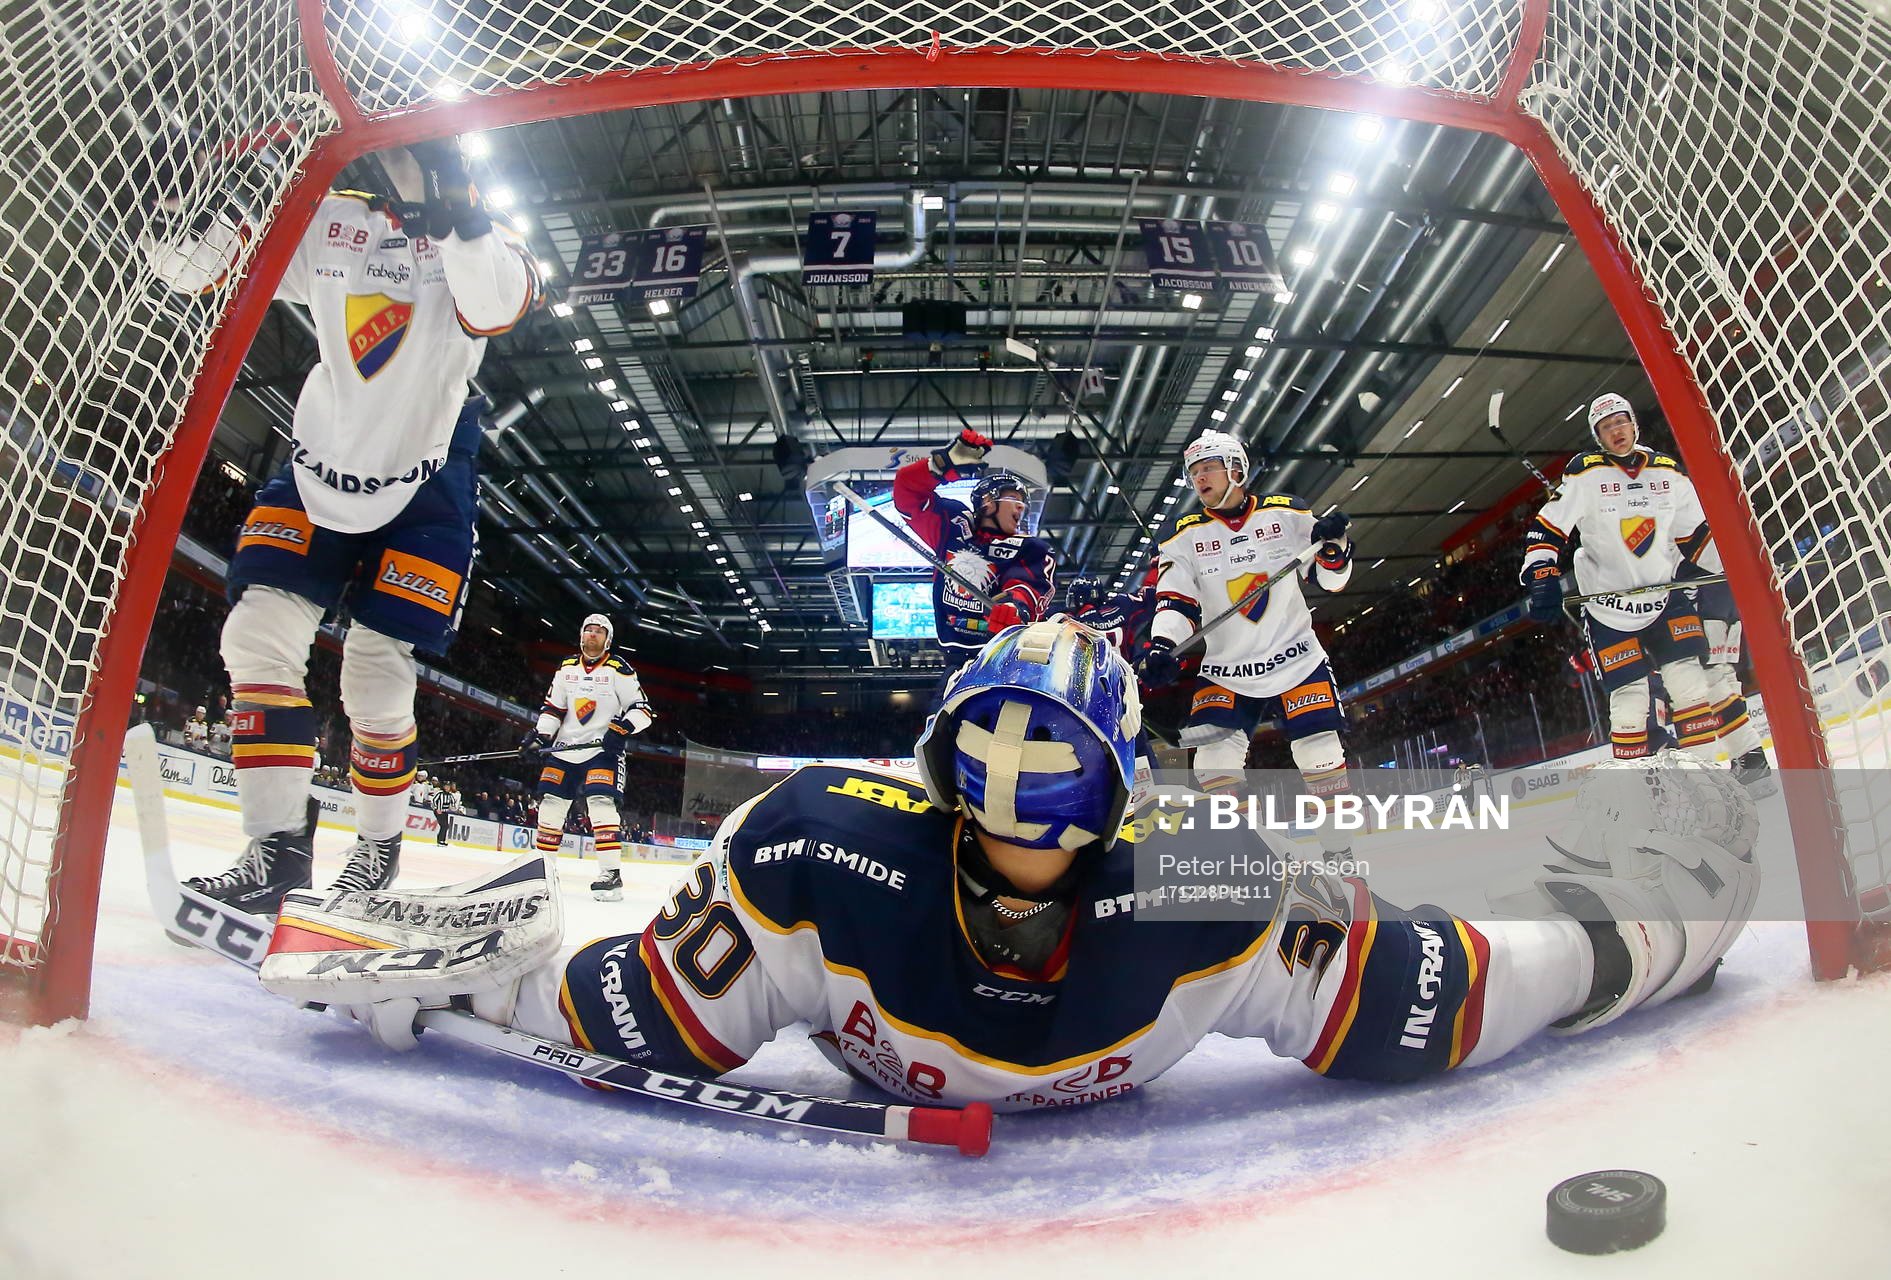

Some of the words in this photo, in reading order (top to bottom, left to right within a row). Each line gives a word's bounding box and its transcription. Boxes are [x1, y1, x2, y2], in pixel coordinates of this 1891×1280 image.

[831, 231, 852, 258] 7
[1159, 236, 1196, 265] 15
[1226, 239, 1264, 267] 10
[583, 250, 627, 279] 33
[651, 244, 688, 273] 16
[367, 264, 410, 284] Fabege
[806, 274, 869, 284] JOHANSSON
[1158, 278, 1214, 290] JACOBSSON
[643, 287, 684, 298] HELBER
[381, 560, 451, 605] bilia
[1287, 692, 1332, 714] bilia
[1527, 772, 1560, 791] SAAB
[817, 842, 907, 892] SMIDE
[175, 891, 266, 962] CC
[306, 929, 505, 975] CCM
[972, 983, 1057, 1006] CCM
[532, 1045, 585, 1070] PRO
[643, 1072, 815, 1123] CCM
